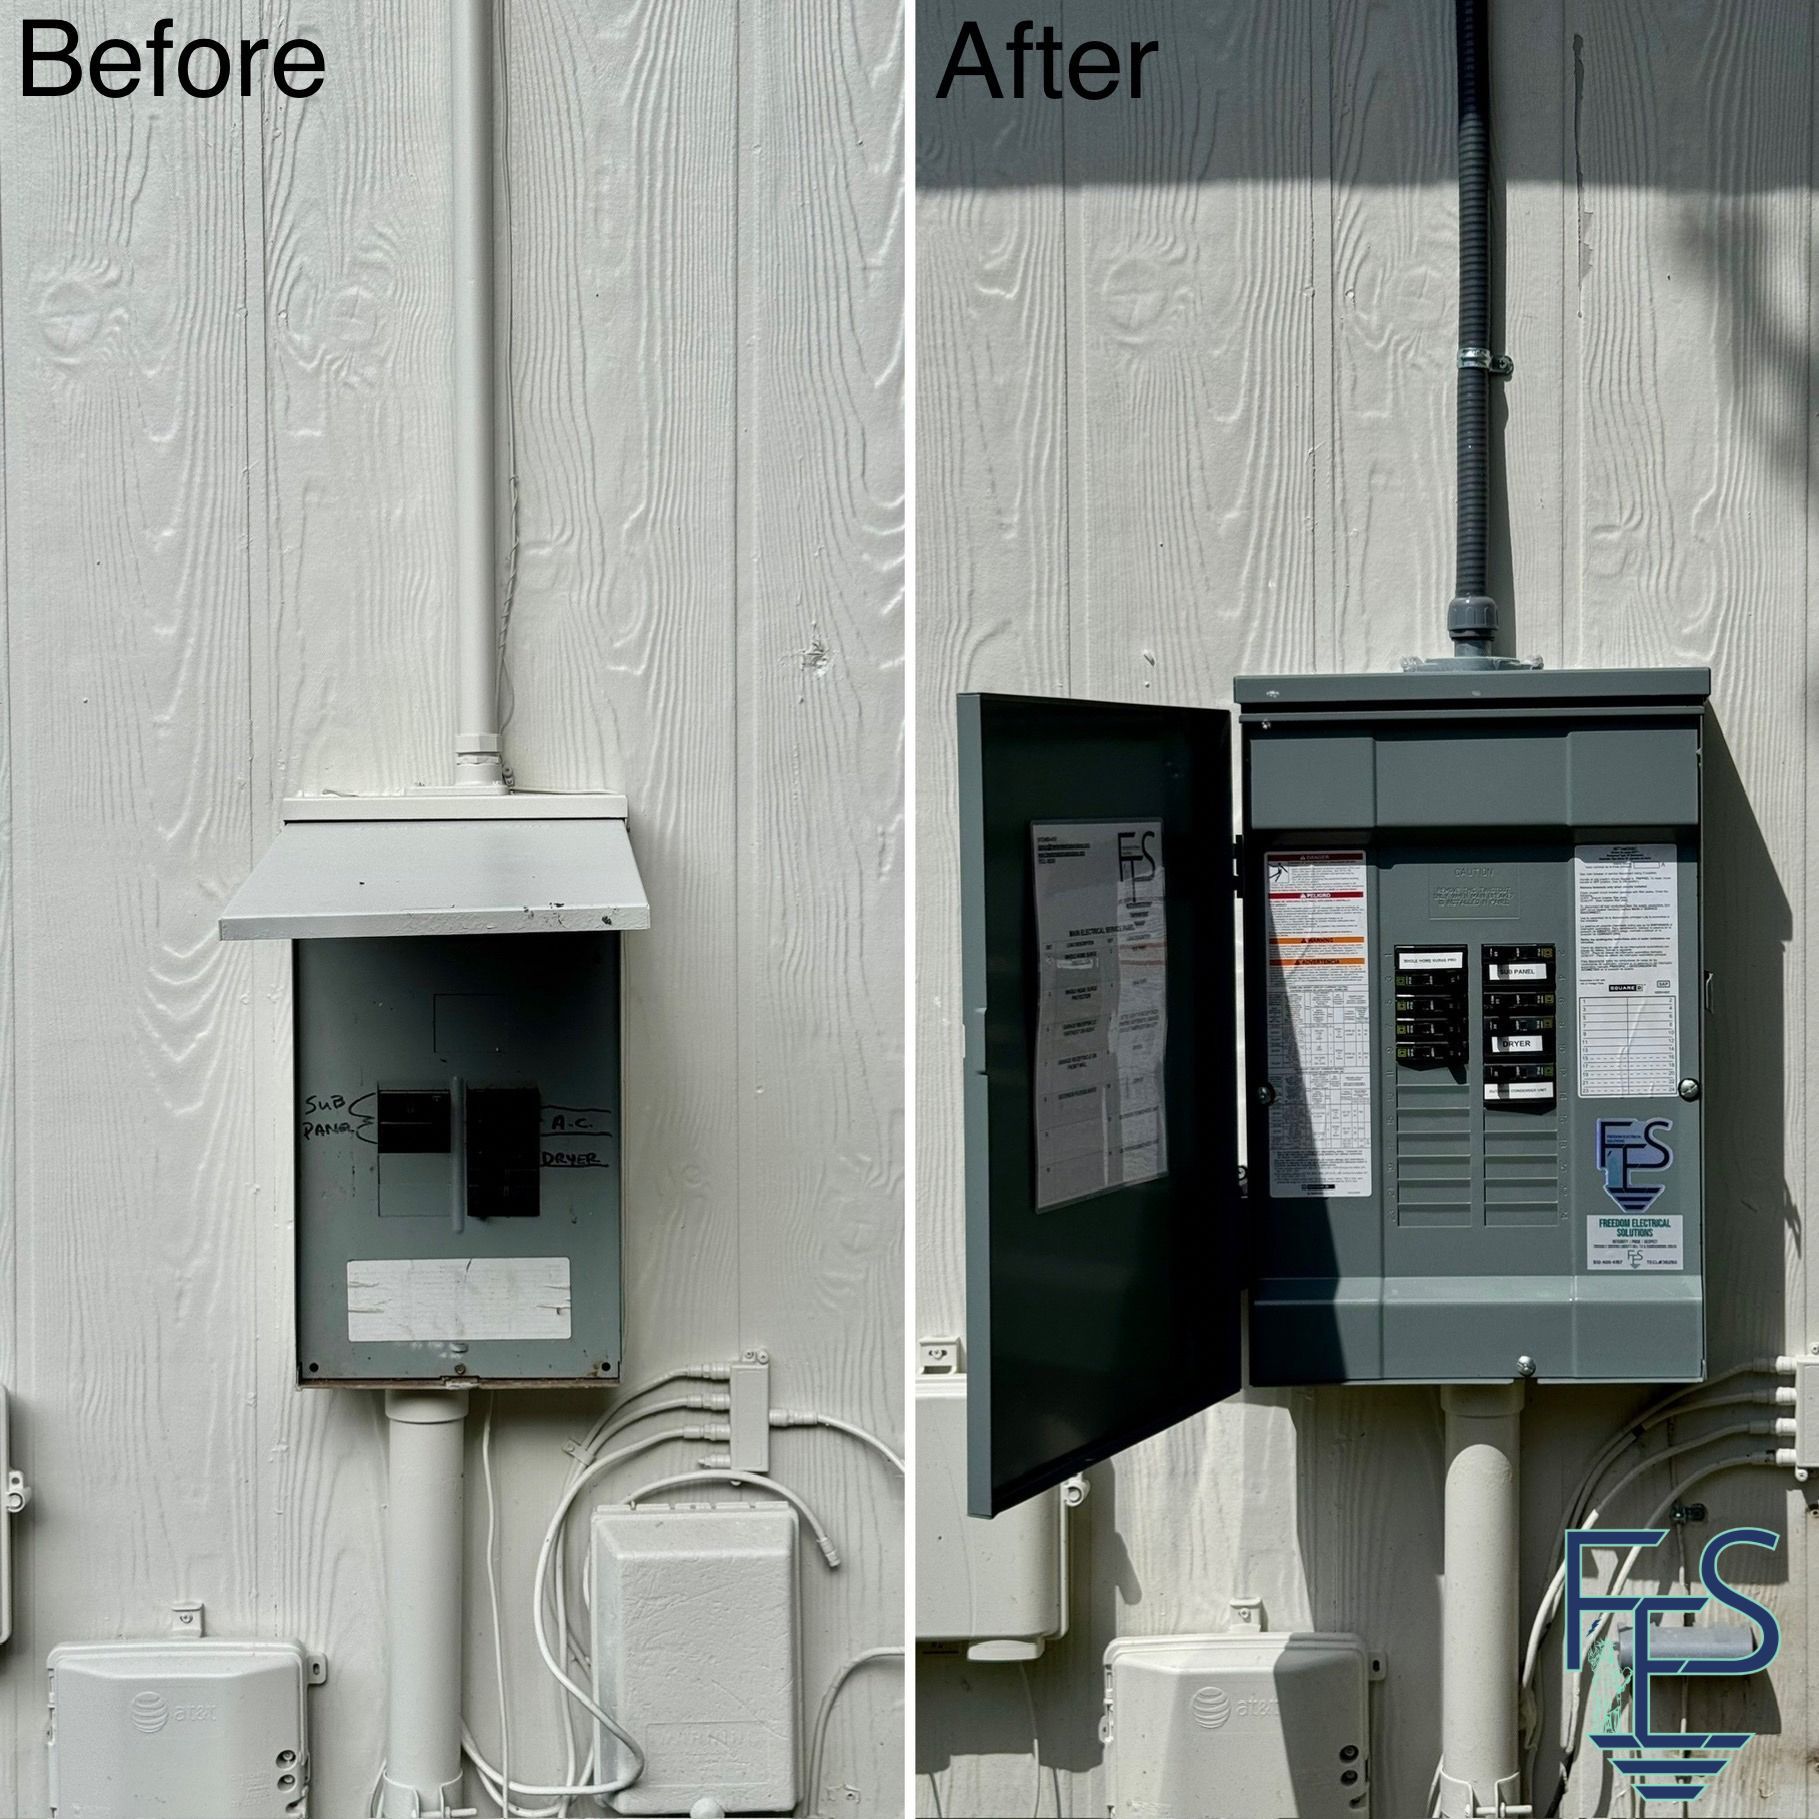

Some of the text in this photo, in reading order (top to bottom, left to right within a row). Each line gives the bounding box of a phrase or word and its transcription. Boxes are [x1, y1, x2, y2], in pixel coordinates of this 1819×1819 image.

[542, 1152, 600, 1166] DRYER
[1599, 1218, 1671, 1228] FREEDOM ELECTRICAL
[1616, 1229, 1653, 1237] SOLUTIONS
[174, 1704, 217, 1722] at&t
